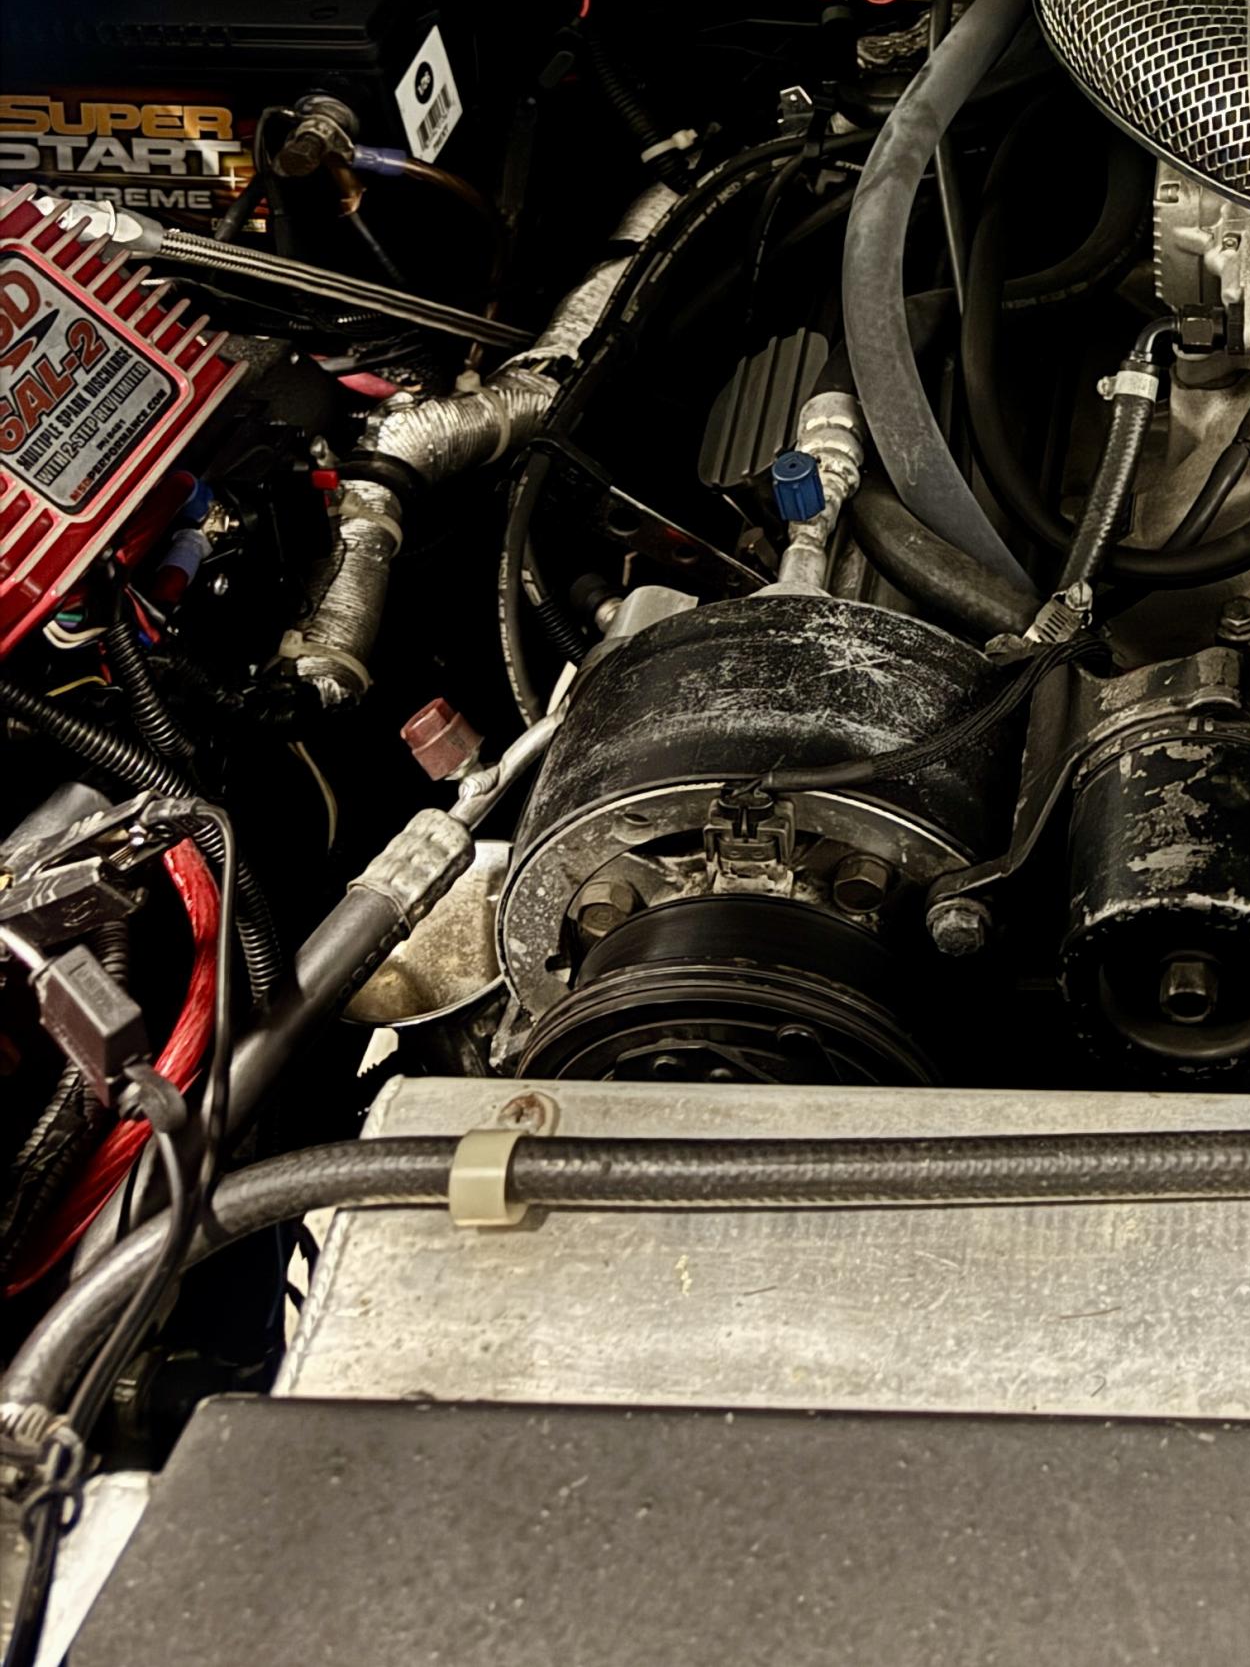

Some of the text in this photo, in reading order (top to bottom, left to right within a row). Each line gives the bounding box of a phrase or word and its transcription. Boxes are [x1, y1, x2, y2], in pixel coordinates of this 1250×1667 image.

[0, 96, 233, 140] SUPER
[0, 133, 242, 176] START
[16, 346, 133, 472] MULTIPLE SPARK DISCHARGE
[34, 360, 151, 487] WITH 2-STEP REV LIMITER
[70, 388, 167, 502] MSDPERFORMANCE.COM
